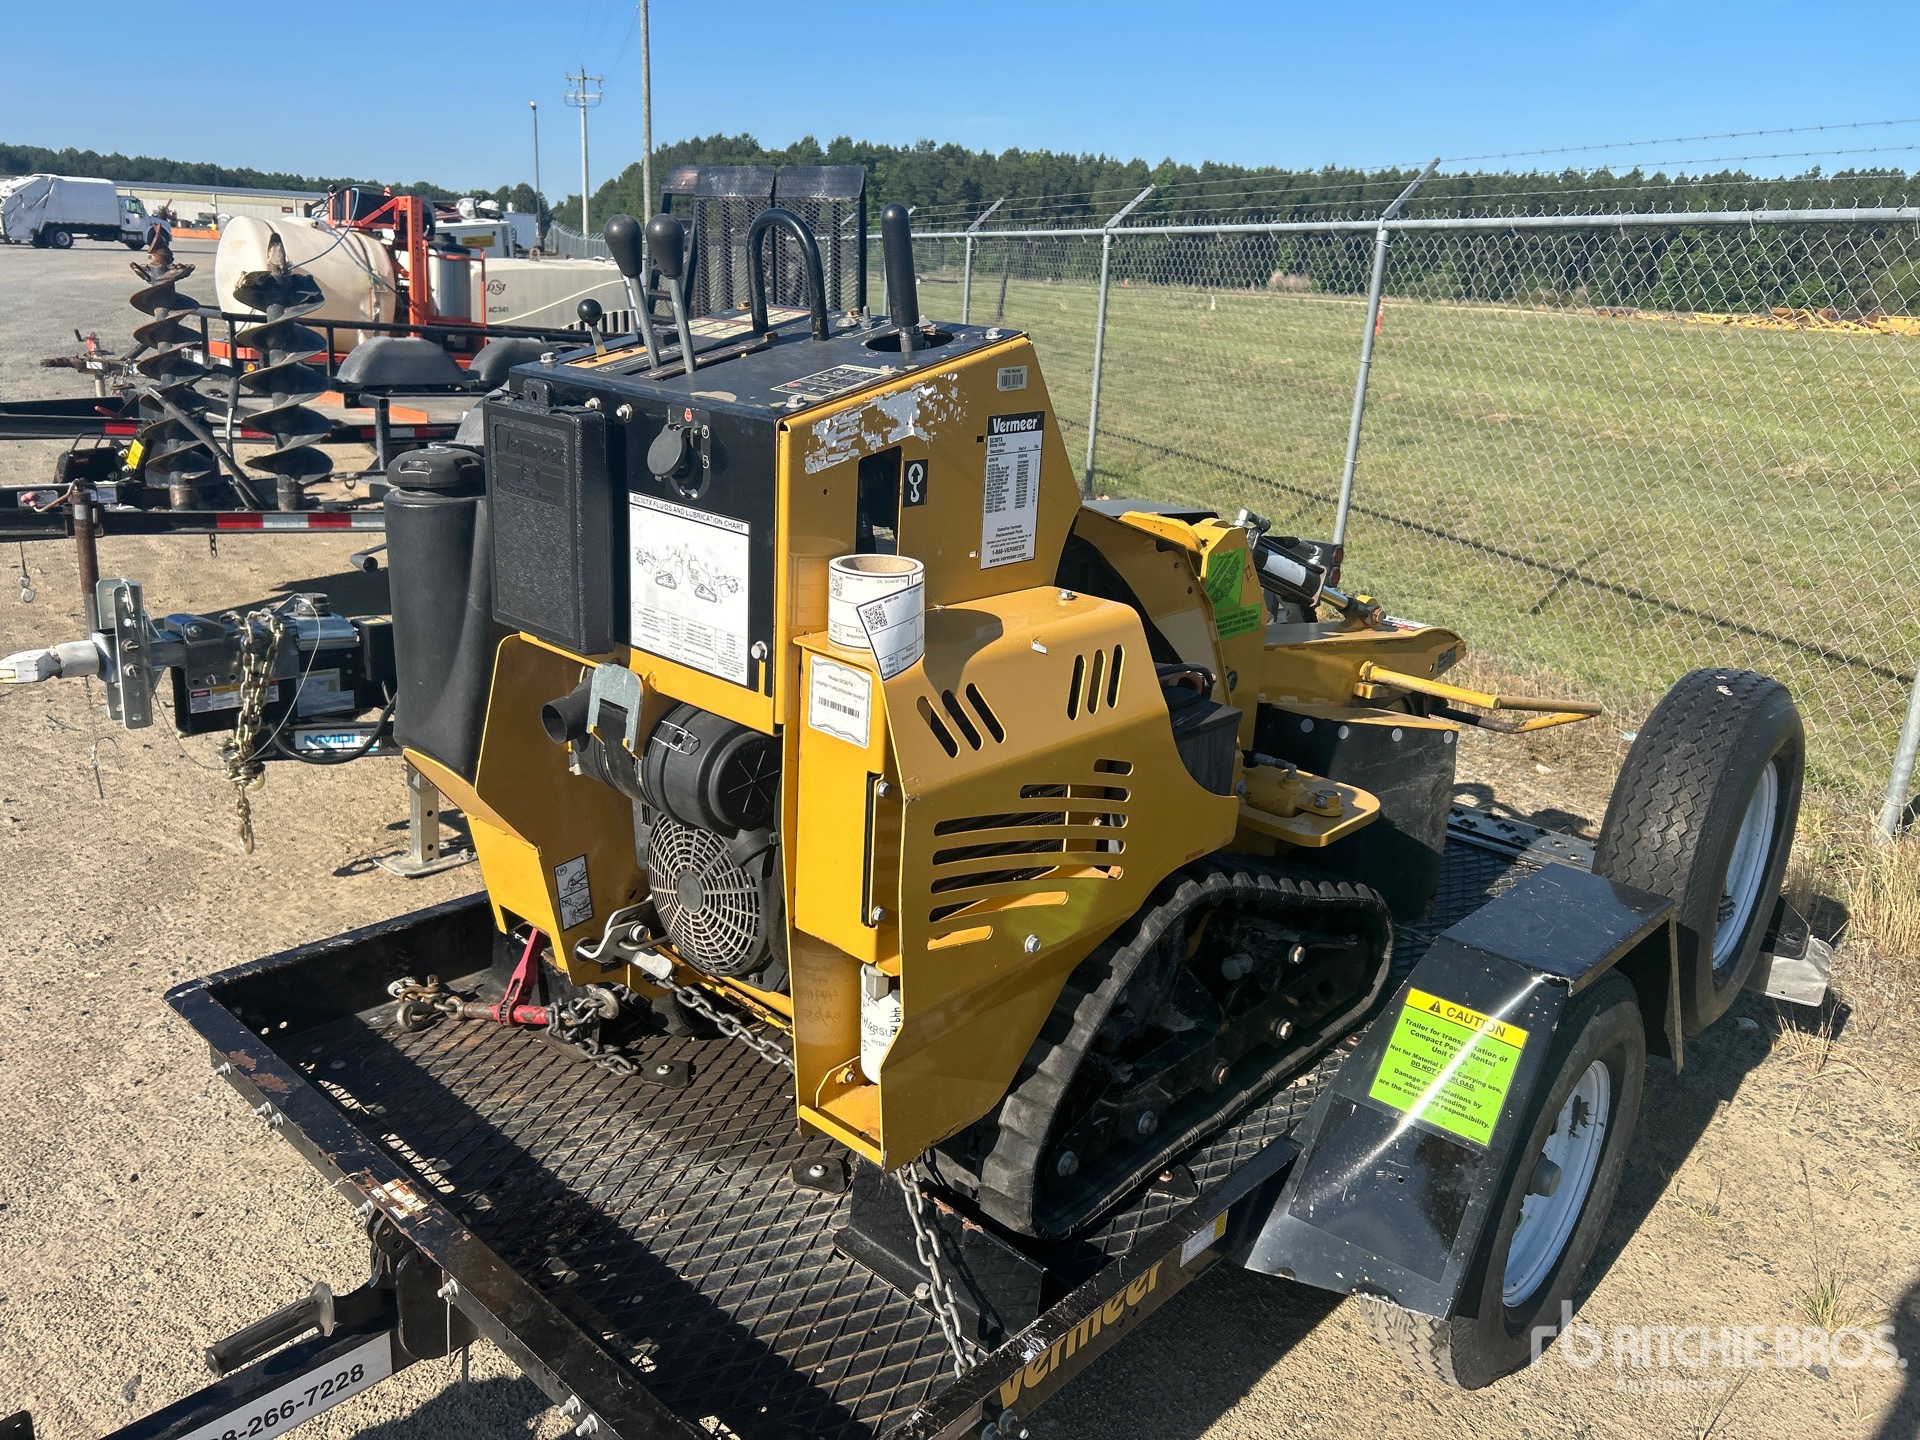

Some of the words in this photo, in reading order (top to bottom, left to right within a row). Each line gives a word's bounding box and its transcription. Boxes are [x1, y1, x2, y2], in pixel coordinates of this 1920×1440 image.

[992, 414, 1037, 433] Vermeer
[653, 500, 672, 511] FLUIDS
[673, 506, 684, 515] AND
[685, 509, 722, 525] LUBRICATION
[724, 519, 743, 531] CHART
[1445, 1005, 1506, 1037] CAUTION
[1404, 1017, 1429, 1032] Trailer
[1429, 1027, 1440, 1036] for
[1440, 1032, 1497, 1060] transptation
[1498, 1054, 1508, 1063] of
[1409, 1028, 1443, 1047] Compact
[1469, 1052, 1496, 1067] Rental
[1430, 1046, 1447, 1057] Unit
[1389, 1044, 1402, 1052] Not
[1401, 1048, 1412, 1056] for
[1412, 1052, 1438, 1067] Material
[1456, 1070, 1487, 1088] Carrying
[1410, 1059, 1421, 1068] DO
[1421, 1064, 1436, 1074] NOT
[1378, 1077, 1390, 1086] are
[1390, 1082, 1402, 1091] the
[1439, 1103, 1490, 1129] responsibility.
[1393, 1067, 1421, 1084] Damage
[1472, 1100, 1482, 1110] by
